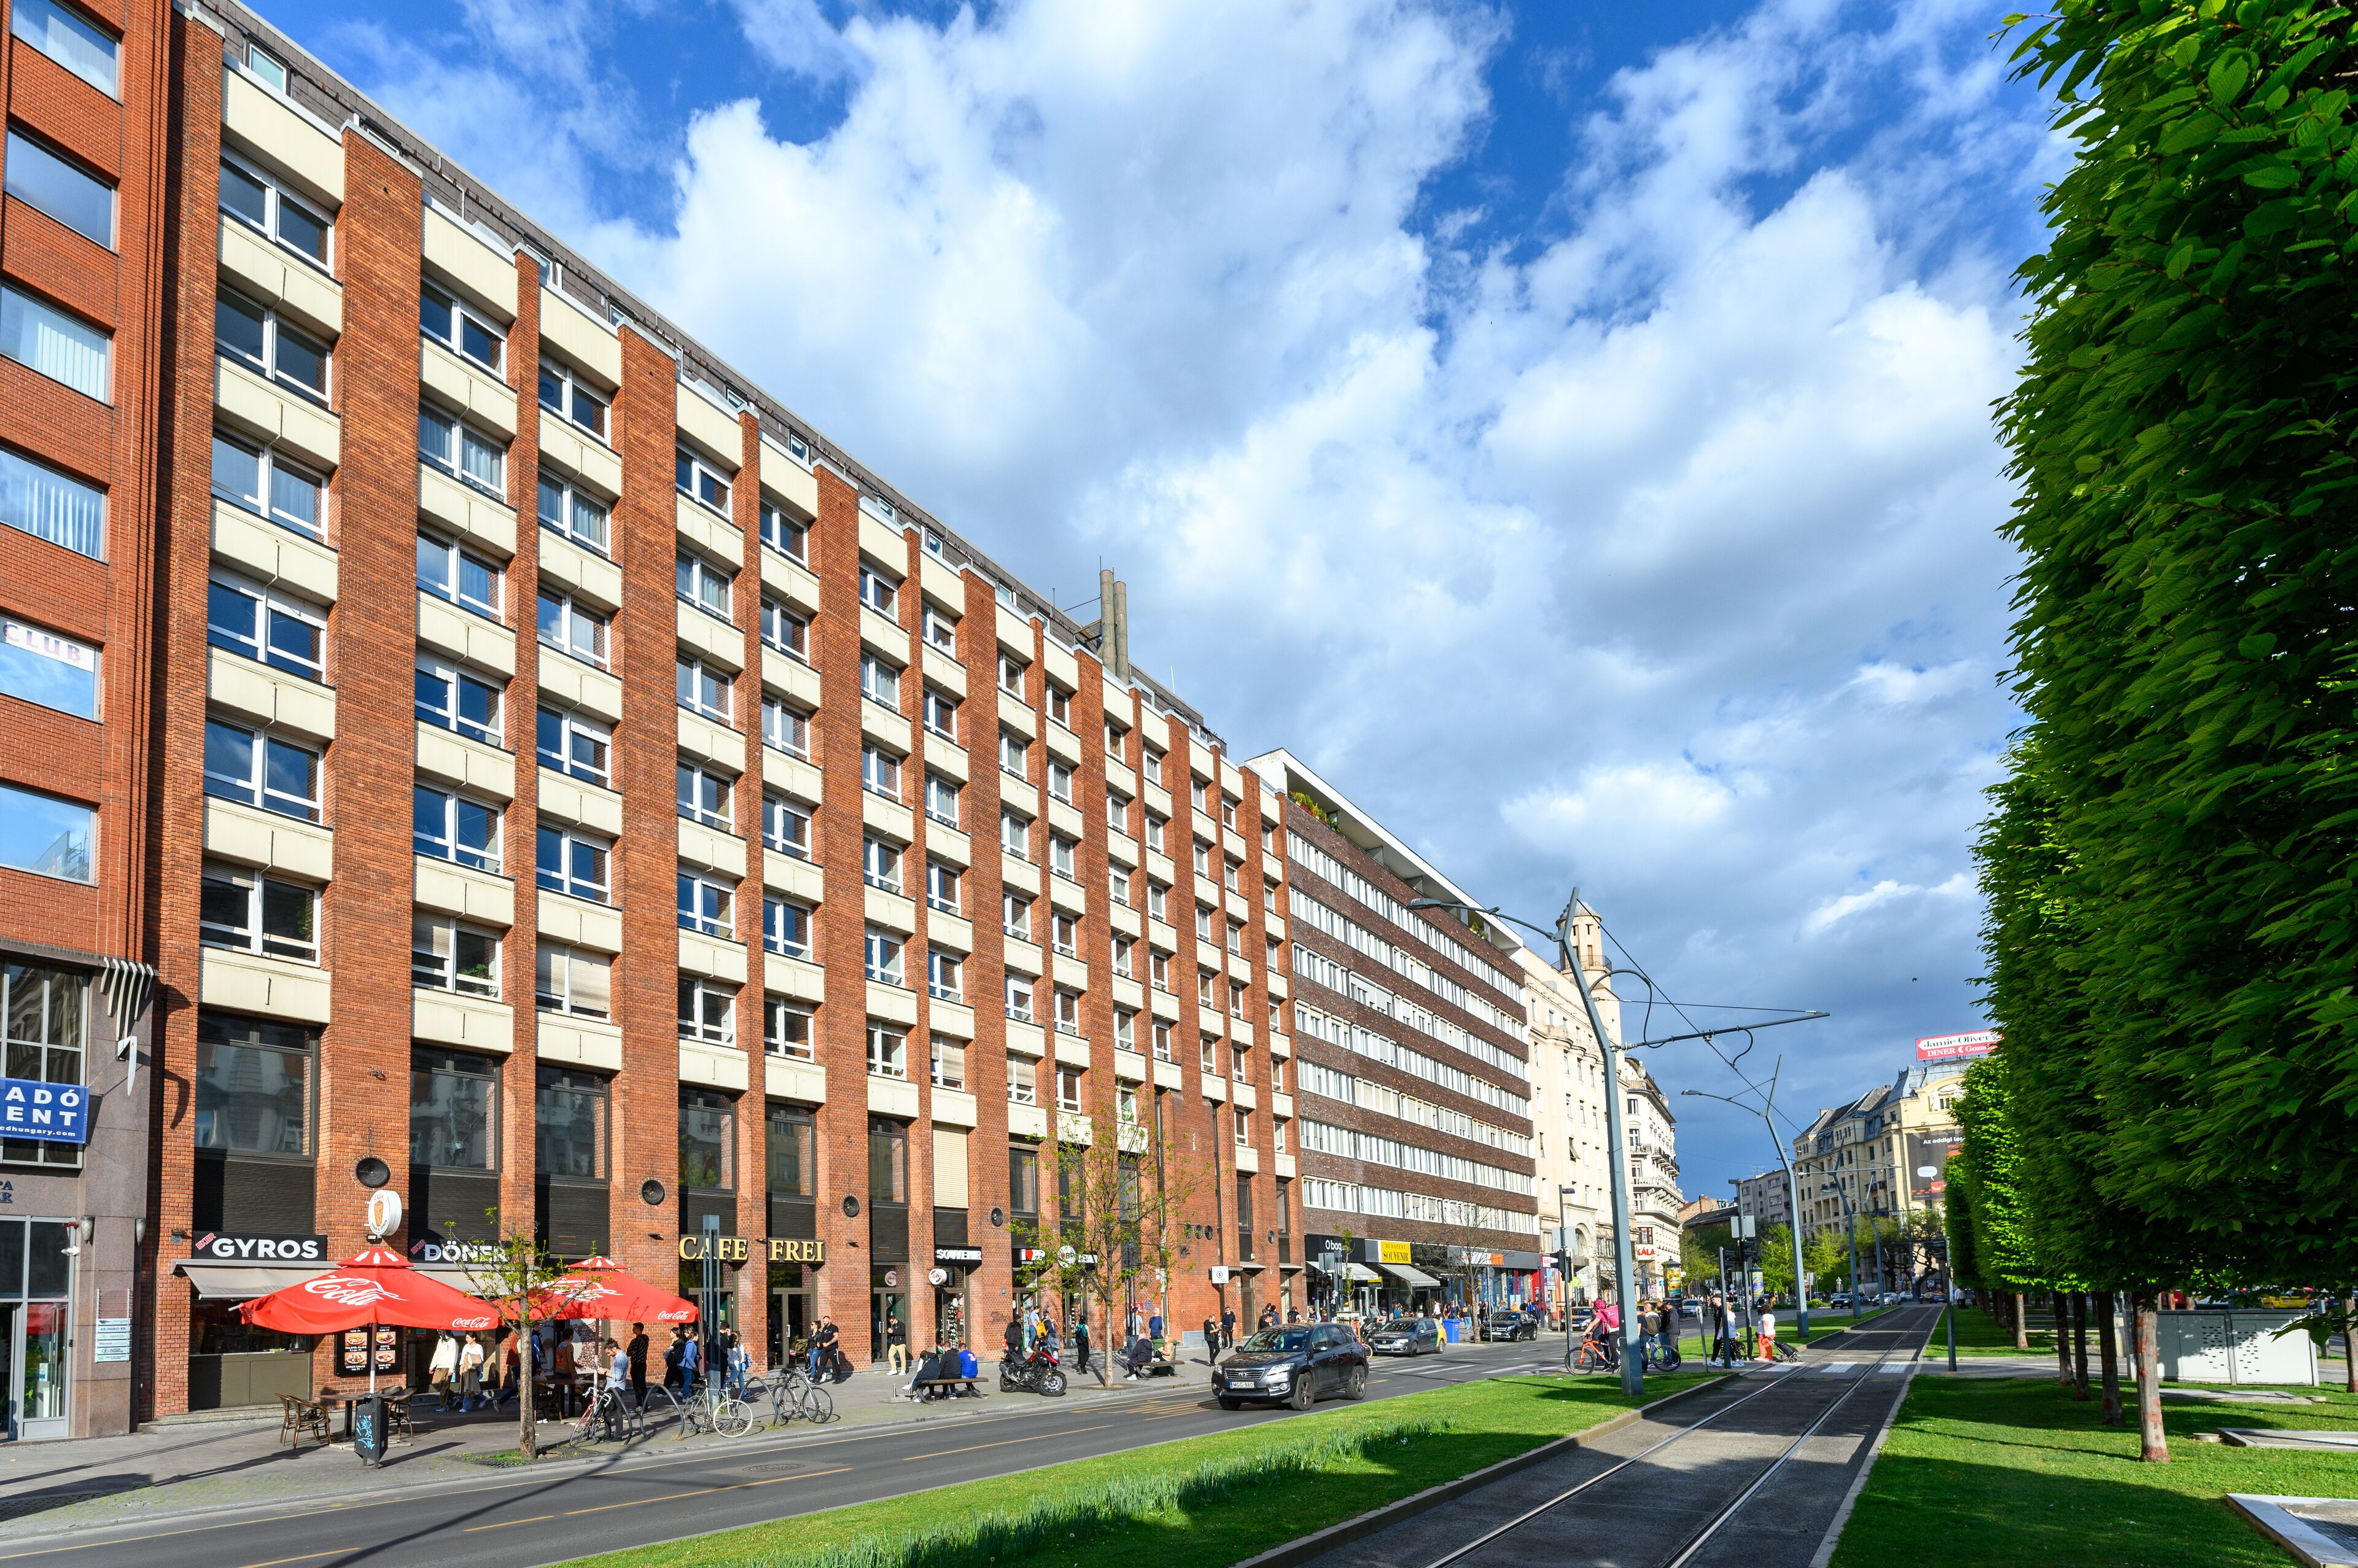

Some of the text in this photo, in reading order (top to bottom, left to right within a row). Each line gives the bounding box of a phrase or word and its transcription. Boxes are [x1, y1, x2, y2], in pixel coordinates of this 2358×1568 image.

[3, 624, 80, 662] CLUB
[1924, 1039, 1955, 1047] Jamie
[1927, 1047, 1956, 1057] DINER
[5, 1086, 79, 1107] ADÓ
[6, 1106, 77, 1126] ENT
[195, 1233, 216, 1250] EKER
[212, 1238, 319, 1259] GYROS
[410, 1239, 426, 1255] EKER
[679, 1237, 824, 1262] CAFE FREI
[425, 1240, 509, 1262] DÖNER
[936, 1249, 982, 1260] SOUVENIR
[1383, 1251, 1409, 1262] SOUVENIR
[452, 1317, 491, 1328] Coca-Cola
[657, 1310, 690, 1321] Coca-Cola
